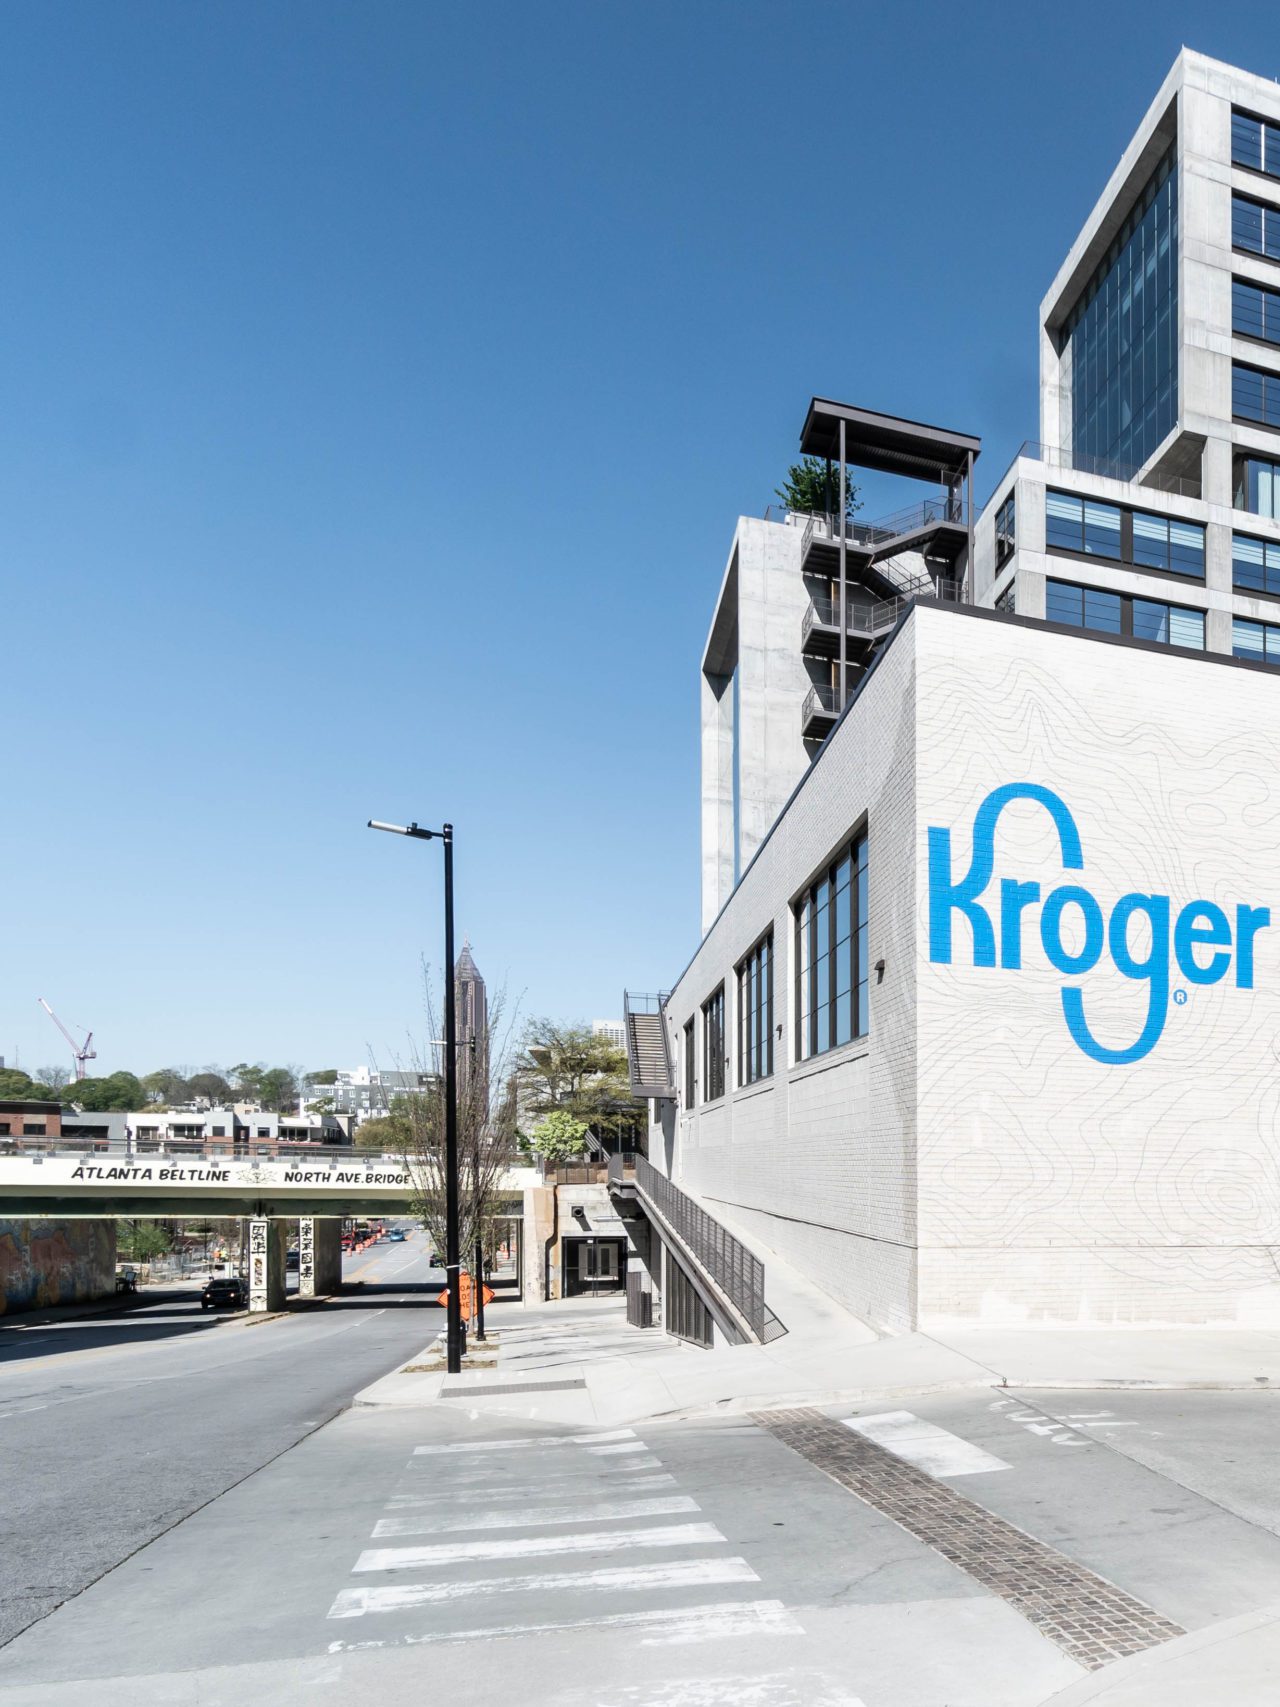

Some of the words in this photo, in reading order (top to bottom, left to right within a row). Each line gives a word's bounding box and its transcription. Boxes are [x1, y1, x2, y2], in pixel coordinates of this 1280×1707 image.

[927, 782, 1271, 1064] Kroger
[71, 1166, 153, 1181] ATLANTA
[158, 1168, 231, 1182] BELTLINE
[283, 1171, 331, 1184] NORTH
